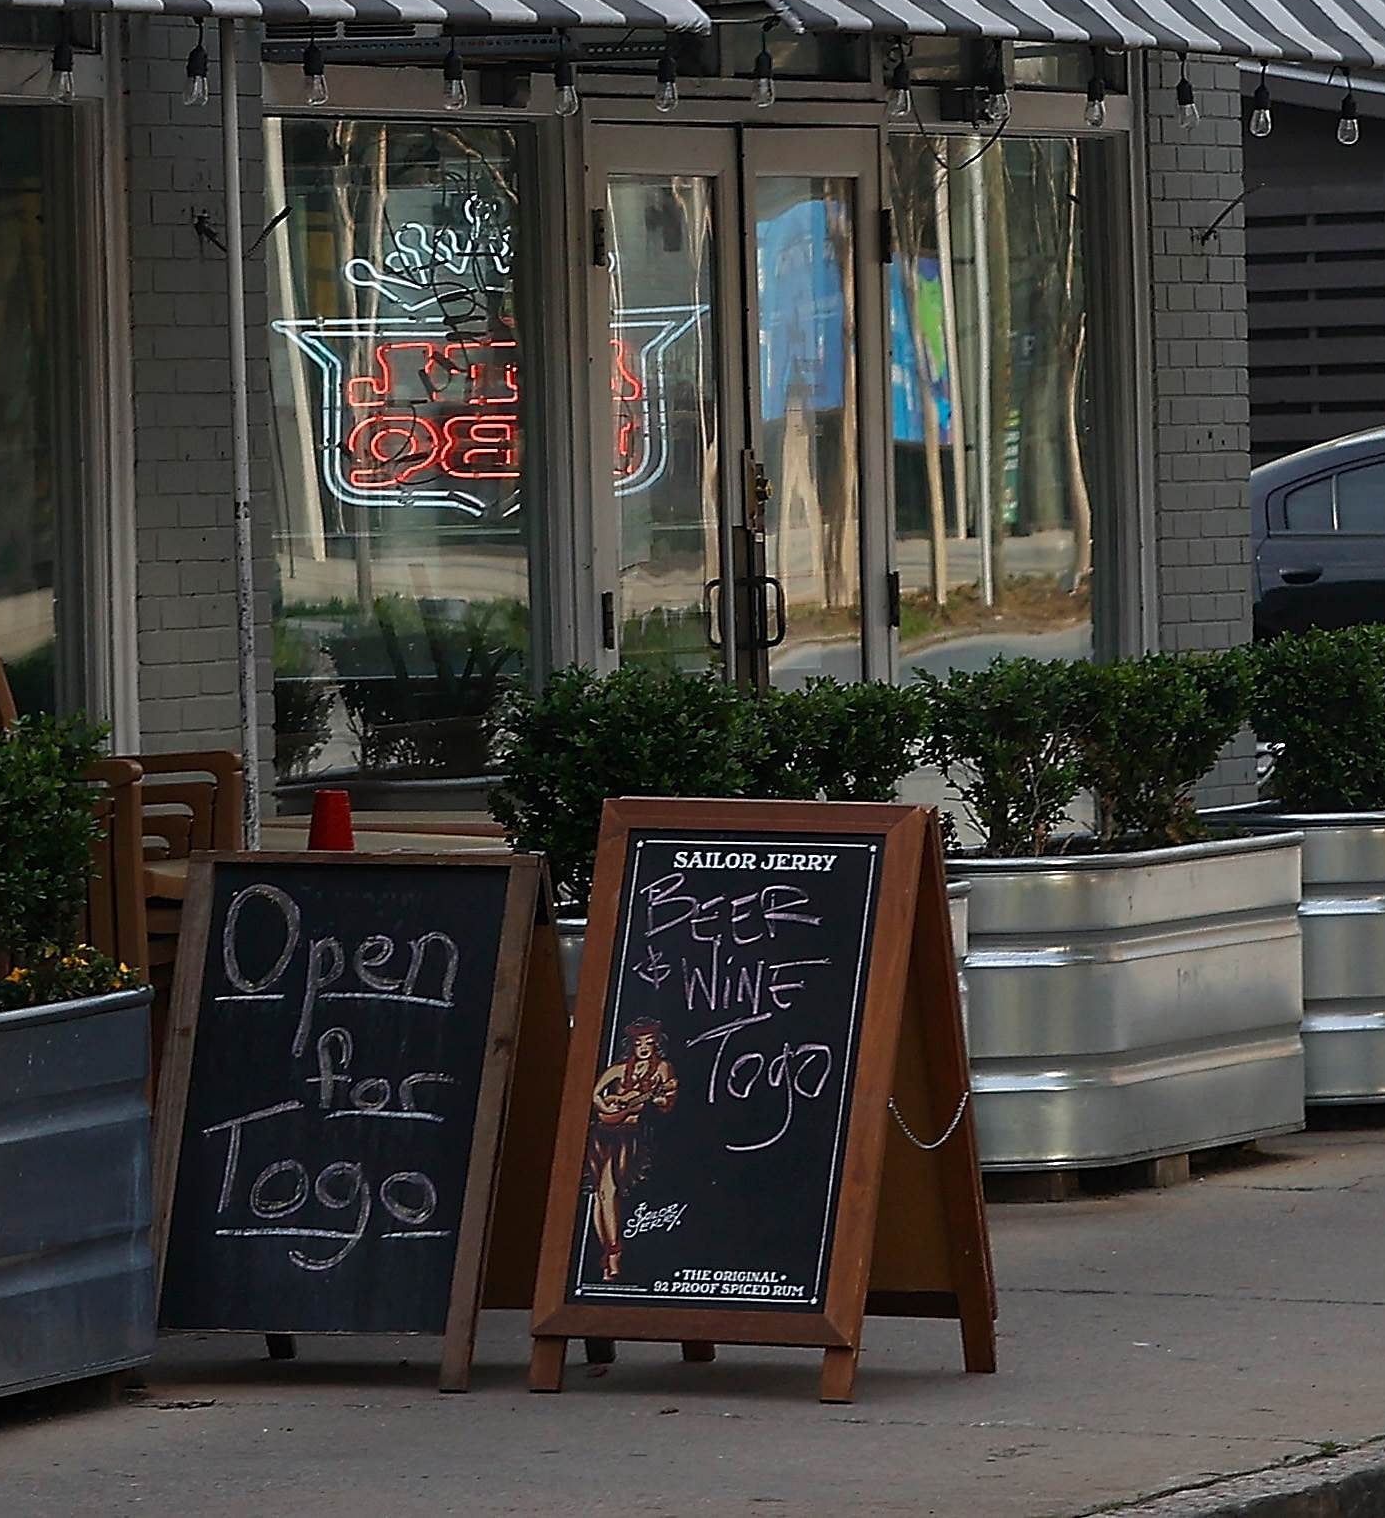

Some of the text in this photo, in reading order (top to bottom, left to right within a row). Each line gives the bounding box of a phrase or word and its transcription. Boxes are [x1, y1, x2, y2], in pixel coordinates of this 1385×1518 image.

[673, 851, 837, 872] SAILOR JERRY
[640, 872, 823, 945] BEER
[223, 883, 460, 1058] Open
[306, 1027, 455, 1111] for
[686, 1012, 833, 1151] Togo
[203, 1099, 438, 1270] Togo
[653, 1281, 670, 1293] 92
[670, 1282, 720, 1294] PROOF
[720, 1283, 772, 1296] SPICED
[772, 1285, 805, 1297] RUM
[681, 1269, 780, 1283] THE ORIGINAL
